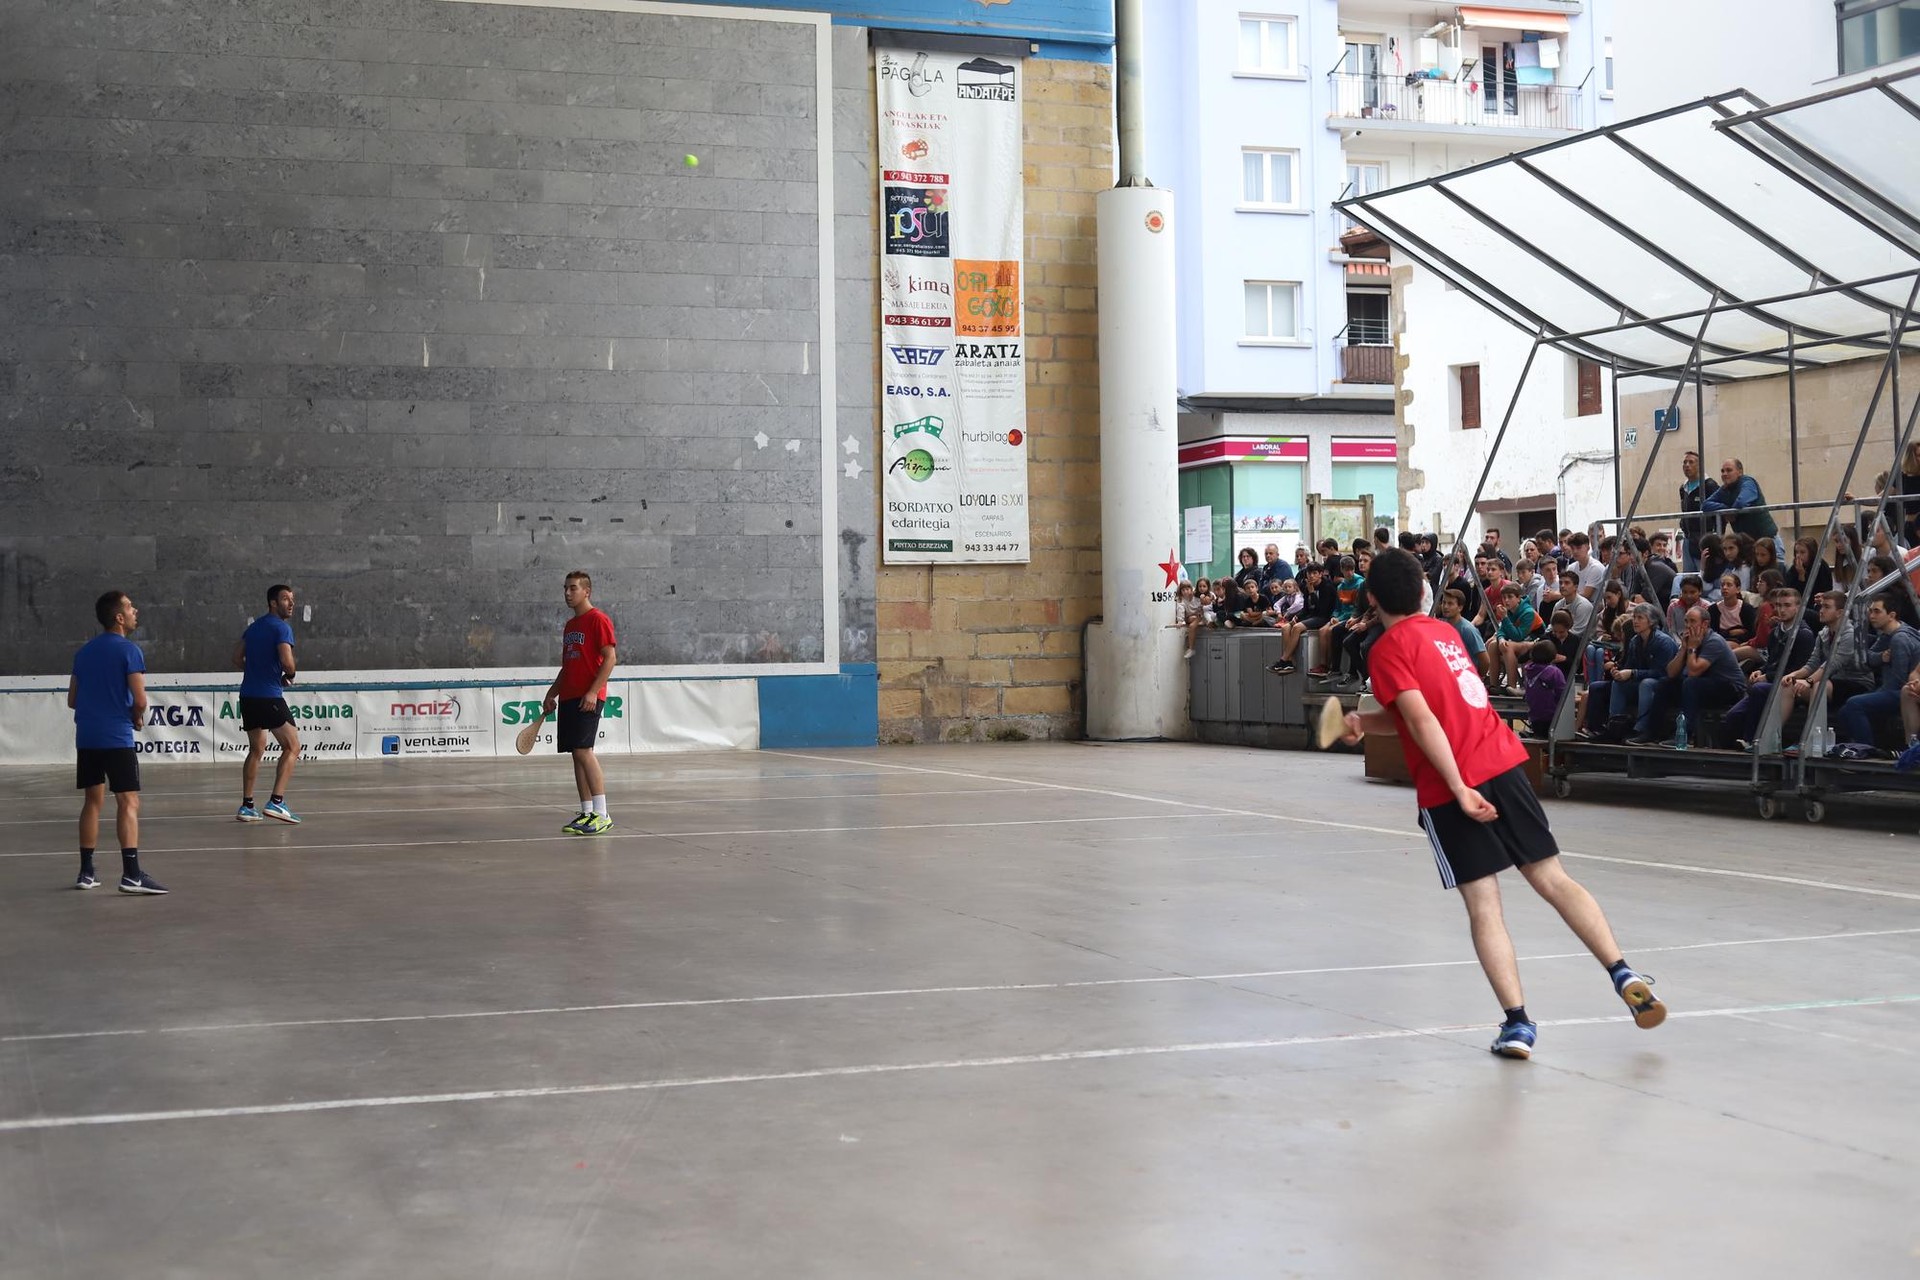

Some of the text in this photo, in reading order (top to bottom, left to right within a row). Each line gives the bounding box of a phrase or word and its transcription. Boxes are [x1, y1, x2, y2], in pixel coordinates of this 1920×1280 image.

[901, 171, 912, 180] 943
[913, 174, 927, 182] 372
[908, 275, 951, 296] kima
[889, 316, 907, 324] 943
[910, 317, 920, 325] 36
[921, 318, 931, 326] 61
[955, 344, 1020, 358] ARATZ
[955, 359, 992, 367] zabaleta
[886, 385, 924, 398] EASO,
[927, 388, 951, 397] S.A.
[960, 494, 996, 506] LOYOLA
[889, 502, 953, 513] BORDATXO
[892, 518, 950, 531] edaritegia
[391, 700, 452, 715] maiz
[148, 705, 205, 726] AGA
[314, 742, 352, 751] denda
[404, 735, 470, 747] ventamix
